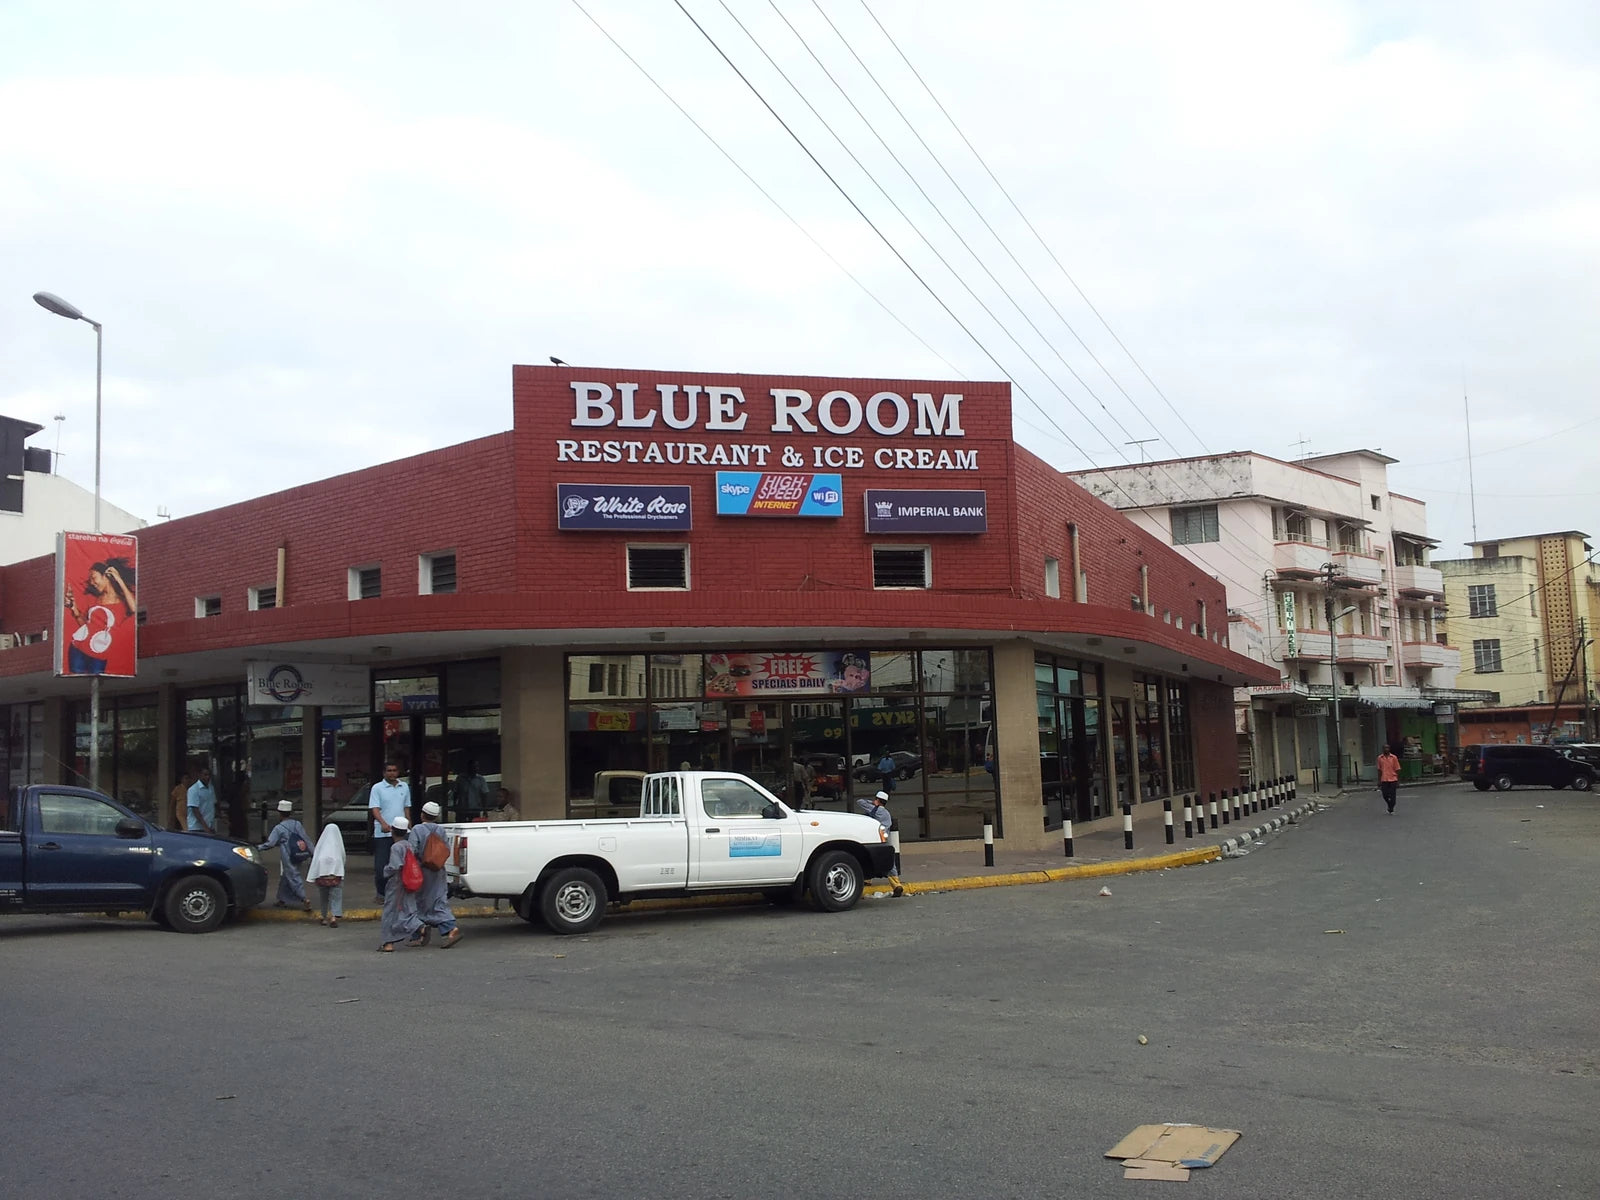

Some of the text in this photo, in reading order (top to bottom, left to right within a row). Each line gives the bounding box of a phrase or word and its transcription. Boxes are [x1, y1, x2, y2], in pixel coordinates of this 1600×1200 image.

[570, 381, 965, 437] BLUE ROOM
[556, 439, 979, 471] RESTAURANT & ICE CREAM
[763, 475, 808, 489] HIGH-
[720, 483, 750, 496] skype
[758, 487, 803, 500] SPEED
[593, 495, 687, 514] White Rose
[753, 501, 799, 510] INTERNET
[898, 506, 984, 517] IMPERIAL BANK
[1287, 629, 1297, 658] BAKERY
[258, 678, 313, 689] Blue Room
[752, 677, 826, 690] SPECIALS DAILY
